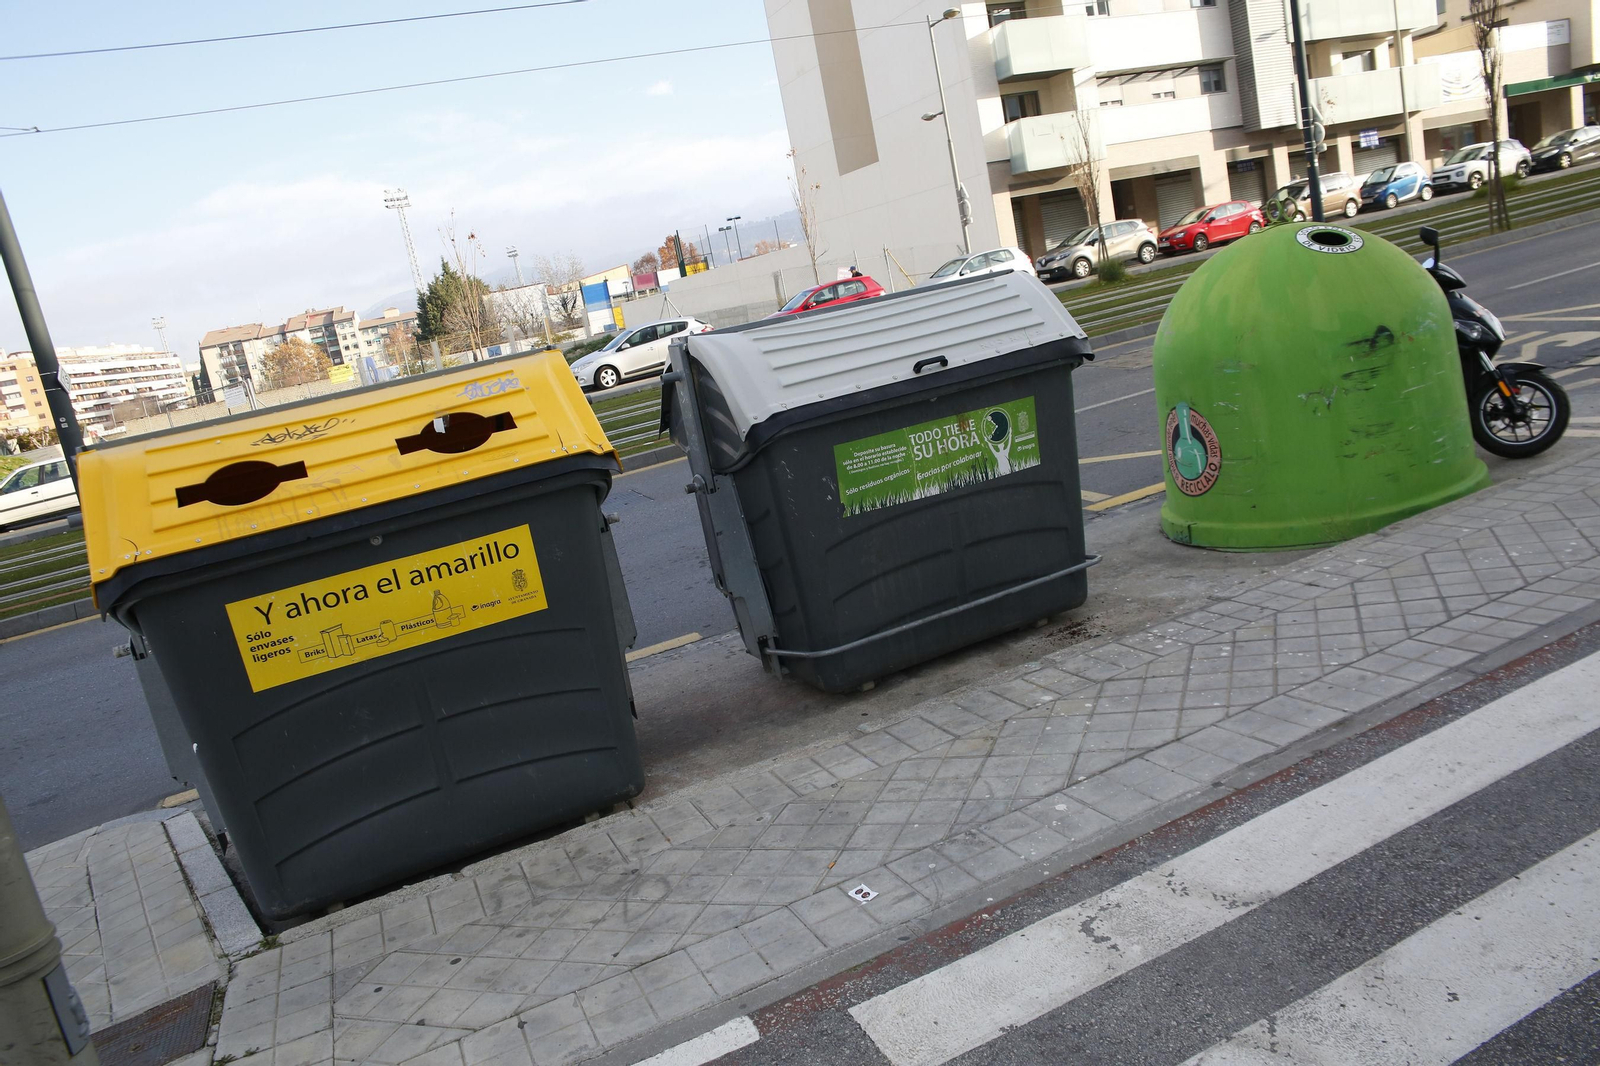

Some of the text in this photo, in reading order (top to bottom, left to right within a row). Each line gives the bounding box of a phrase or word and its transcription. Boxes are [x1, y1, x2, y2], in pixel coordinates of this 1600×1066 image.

[1319, 244, 1356, 252] VIDRIO
[909, 419, 976, 445] TODO TIENE
[1190, 414, 1218, 458] muchas vidas
[853, 448, 874, 457] Deposite
[880, 443, 896, 451] basura
[864, 452, 881, 460] horario
[881, 446, 907, 456] establecido
[913, 431, 980, 461] SU HORA
[917, 451, 983, 480] Gracias por colaborar
[846, 487, 858, 496] Sólo
[884, 468, 911, 482] orgánicos
[254, 540, 520, 625] Y ahora el amarillo
[508, 590, 539, 601] AYUNTAMIENTO
[517, 595, 537, 603] GRANADA
[480, 599, 502, 609] inagra
[400, 616, 435, 631] Plásticos
[246, 630, 272, 643] Sólo
[355, 633, 378, 644] Latas
[250, 635, 295, 653] envases
[252, 647, 292, 663] ligeros
[304, 648, 326, 658] Briks
